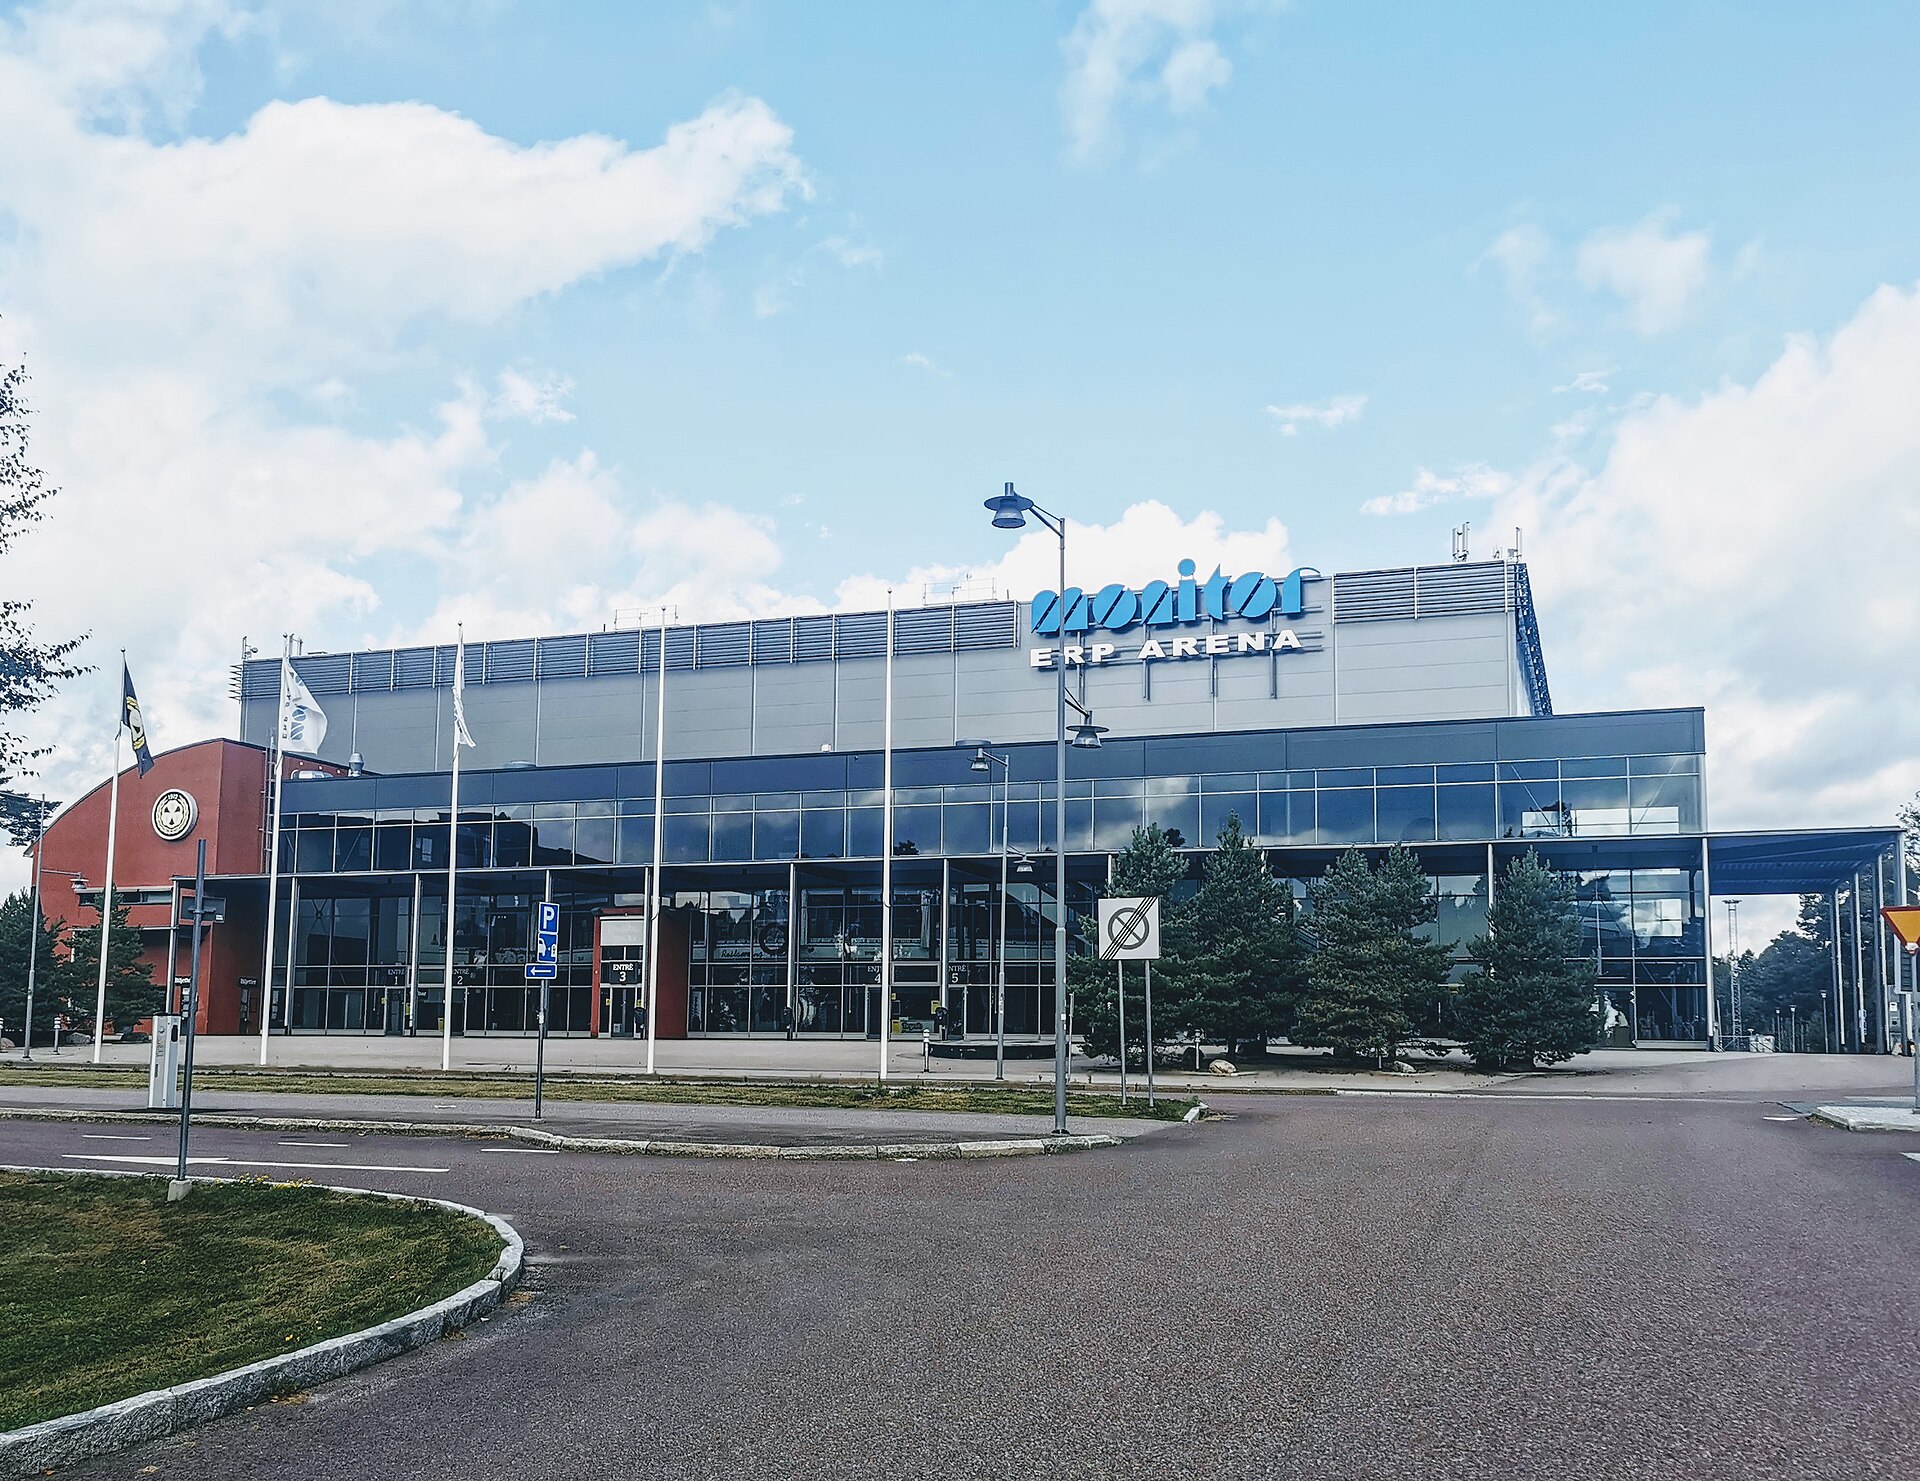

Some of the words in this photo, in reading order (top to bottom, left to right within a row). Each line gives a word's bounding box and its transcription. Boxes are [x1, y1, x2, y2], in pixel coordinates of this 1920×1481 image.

[1031, 558, 1320, 633] monitor
[1030, 643, 1115, 667] ERP
[1137, 629, 1302, 660] ARENA
[543, 906, 555, 929] P
[948, 964, 966, 972] NTRÉ
[394, 976, 398, 985] 1
[457, 976, 463, 985] 2
[619, 971, 627, 982] 3
[874, 973, 881, 983] 4
[951, 973, 959, 983] 5
